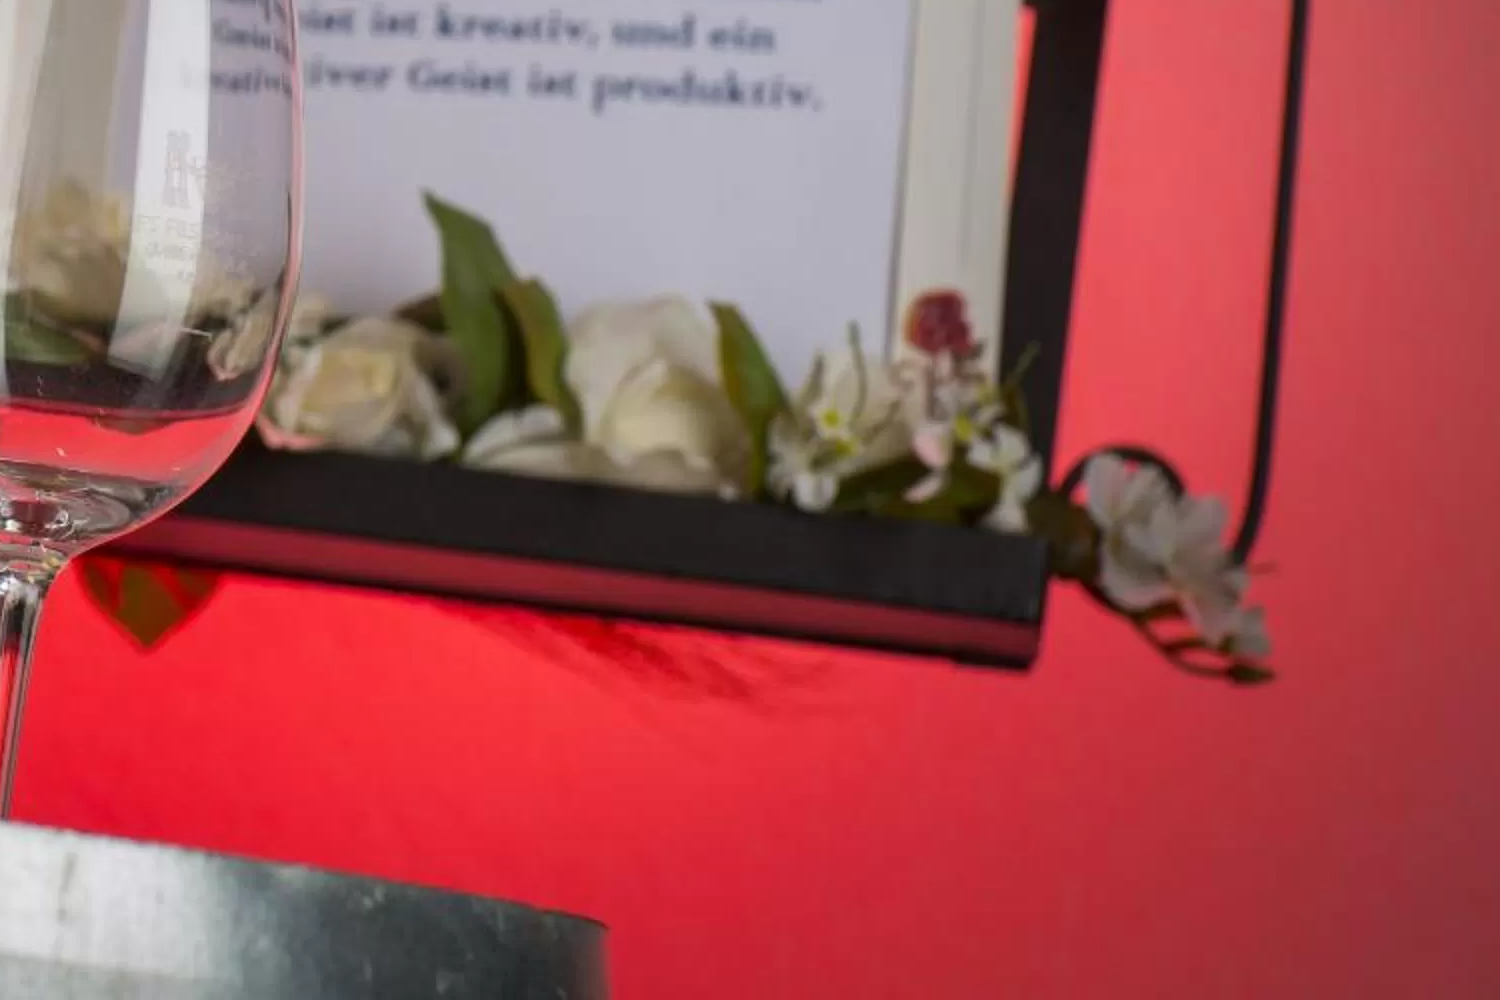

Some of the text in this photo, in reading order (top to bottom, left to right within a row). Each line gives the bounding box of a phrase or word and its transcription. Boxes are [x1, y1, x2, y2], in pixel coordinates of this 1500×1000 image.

[370, 3, 418, 36] ist
[434, 3, 598, 47] kreativ,
[610, 11, 696, 48] und
[708, 19, 775, 53] ein
[407, 58, 511, 93] Geist
[526, 62, 575, 96] ist
[592, 67, 822, 116] produktiv.
